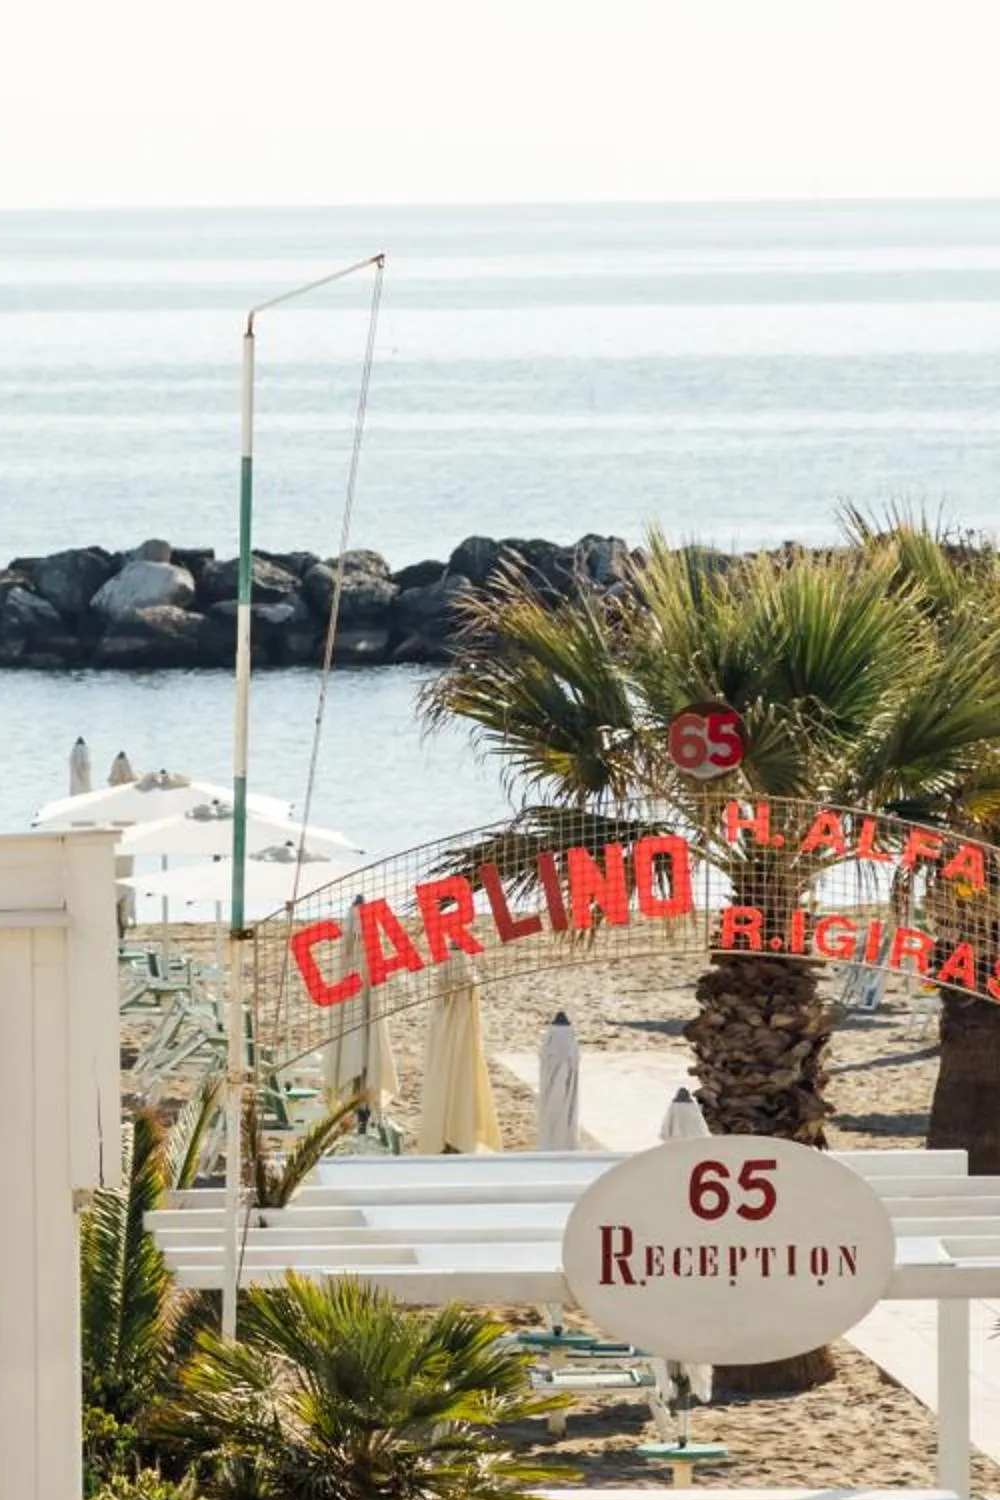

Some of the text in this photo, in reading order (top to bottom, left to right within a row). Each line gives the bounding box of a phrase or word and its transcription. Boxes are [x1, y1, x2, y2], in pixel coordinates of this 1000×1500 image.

[668, 711, 744, 769] 65
[290, 835, 693, 1008] CARLINO
[688, 1159, 777, 1221] 65
[599, 1225, 858, 1287] RECEPTION
